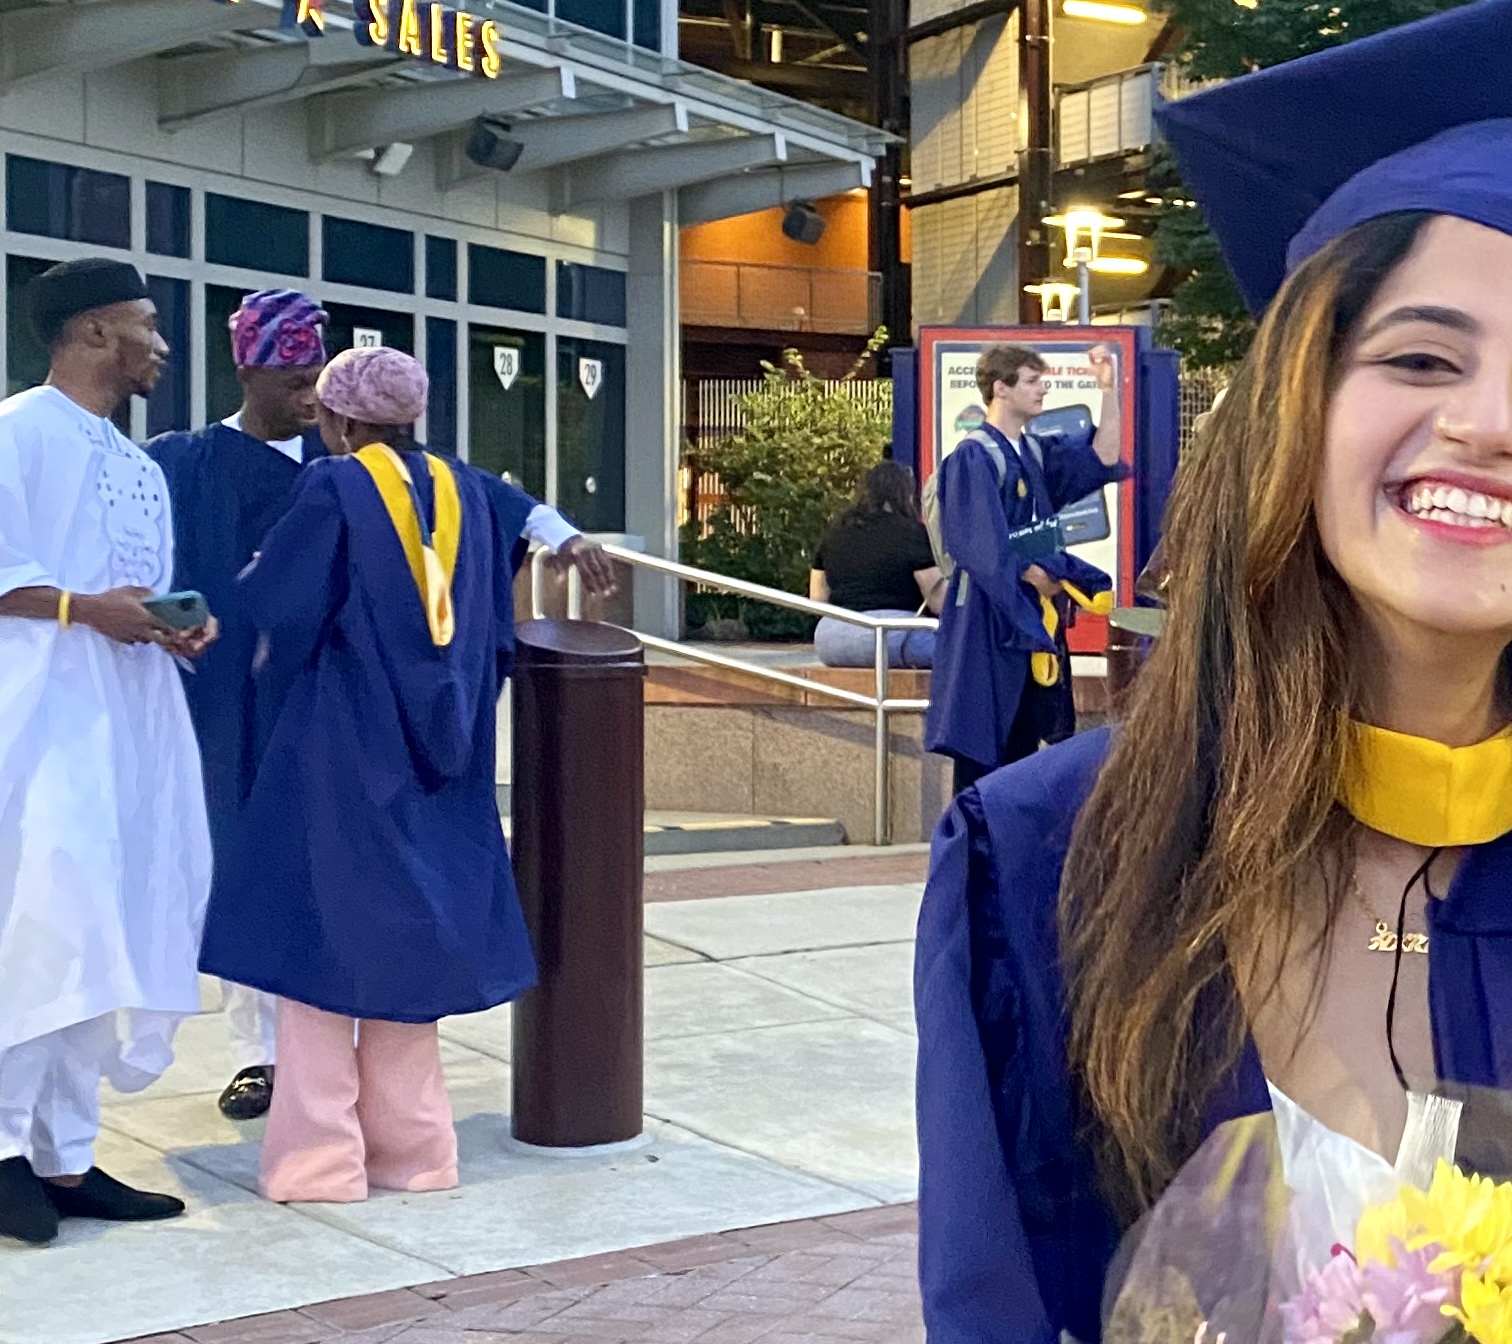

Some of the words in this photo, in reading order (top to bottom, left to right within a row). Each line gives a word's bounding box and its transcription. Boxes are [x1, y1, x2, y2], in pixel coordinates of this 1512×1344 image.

[499, 352, 513, 376] 28
[948, 366, 977, 376] ACCE
[584, 363, 597, 386] 29
[949, 379, 977, 389] BEFO
[1054, 380, 1073, 389] THE
